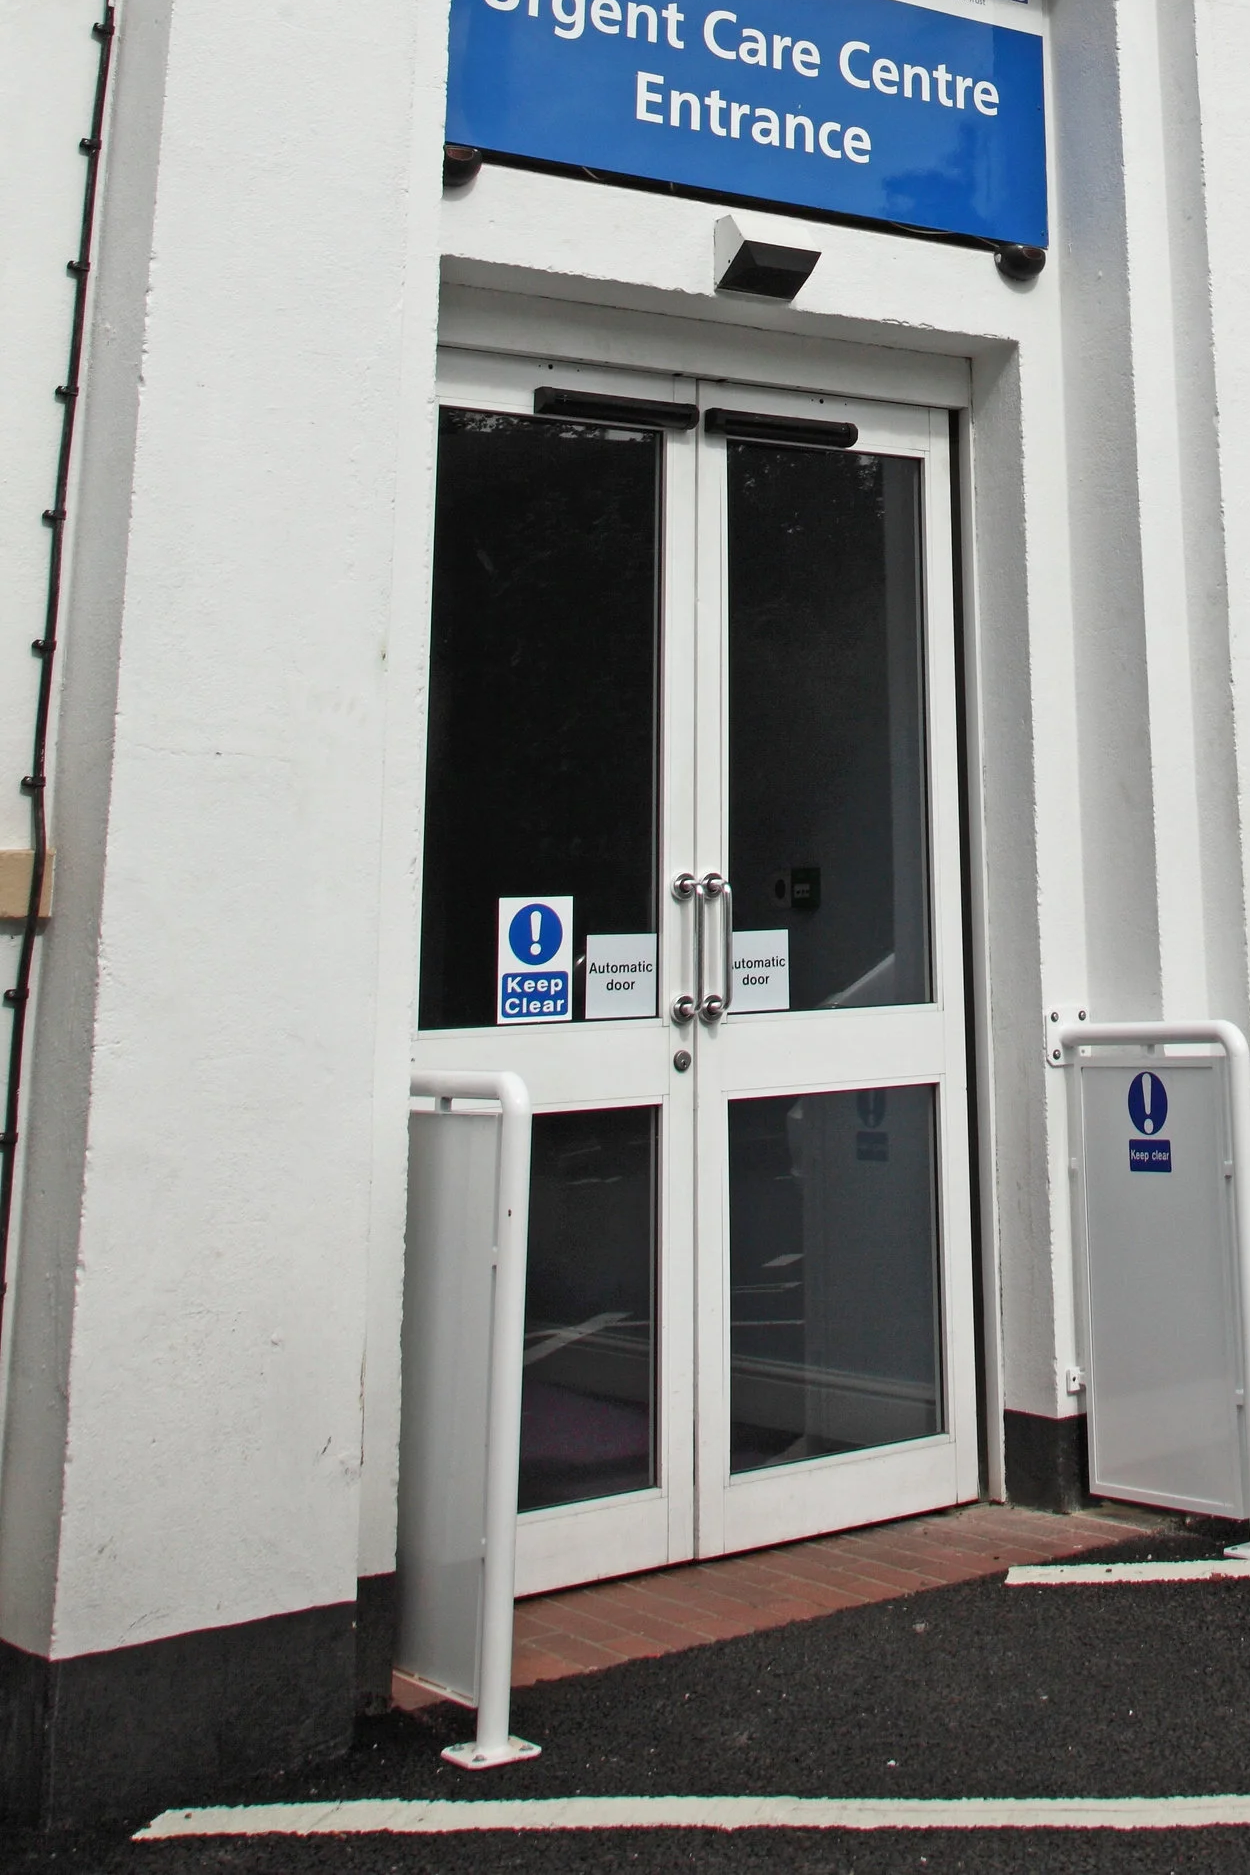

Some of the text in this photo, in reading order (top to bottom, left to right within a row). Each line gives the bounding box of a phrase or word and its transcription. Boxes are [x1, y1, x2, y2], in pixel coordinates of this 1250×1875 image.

[702, 10, 821, 78] Care
[839, 41, 1000, 116] Centre
[635, 71, 872, 164] Entrance
[589, 960, 653, 975] Automatic
[731, 956, 786, 970] utomatic
[506, 976, 564, 994] Keep
[606, 978, 635, 991] door
[742, 973, 770, 986] door
[504, 995, 565, 1015] Clear
[1130, 1149, 1169, 1163] Keep clear
